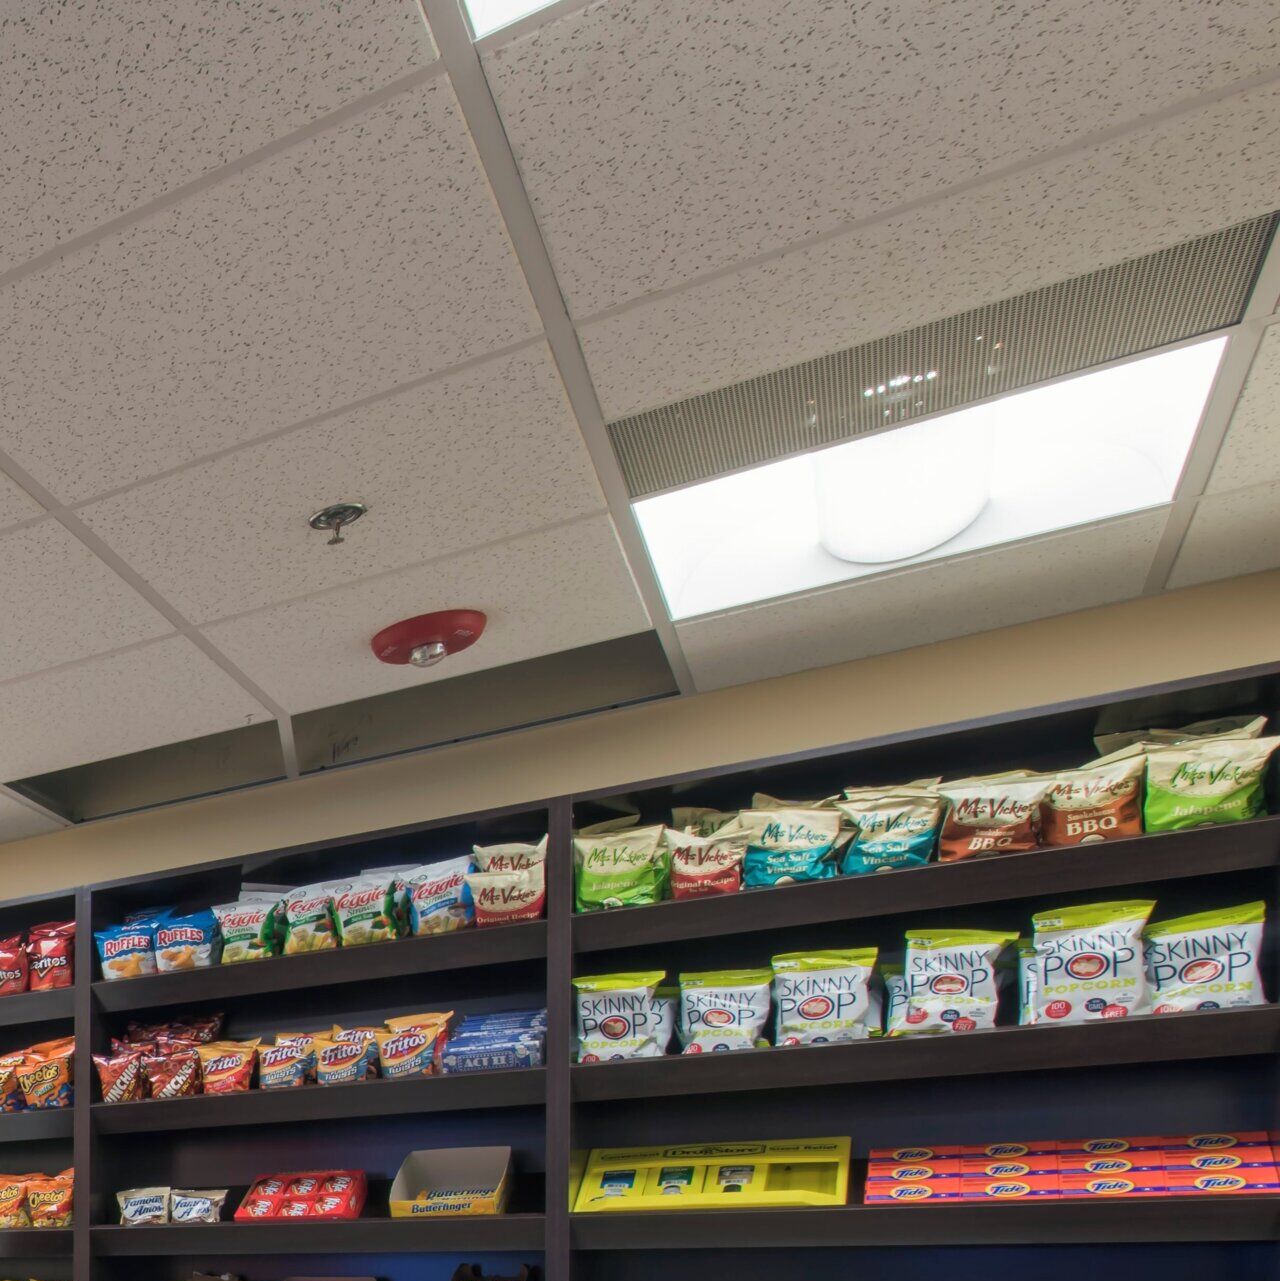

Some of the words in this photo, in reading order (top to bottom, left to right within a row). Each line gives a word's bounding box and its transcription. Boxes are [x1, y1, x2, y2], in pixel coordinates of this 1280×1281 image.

[1083, 779, 1133, 800] Vickie's
[989, 795, 1037, 819] Vickie's
[1067, 808, 1115, 821] Smokehouse
[885, 812, 930, 833] Vickie's
[1066, 816, 1119, 837] BBQ
[784, 824, 829, 844] Vickie's
[968, 835, 1013, 851] BBQ
[698, 844, 738, 866] Vickie's
[766, 853, 787, 864] Sea
[788, 852, 811, 863] Salt
[862, 853, 909, 865] Vinegar
[765, 864, 809, 876] Vinegar
[413, 875, 466, 902] Veggie
[703, 875, 737, 888] Recipe
[334, 886, 387, 912] Veggie
[502, 885, 537, 905] Vickie's
[219, 911, 267, 929] Veggie
[476, 915, 510, 926] Original
[511, 910, 540, 924] Recipe
[105, 937, 151, 957] RUFFLES
[157, 929, 203, 946] RUFFLES
[1041, 927, 1133, 957] SKINNY
[1154, 930, 1247, 964] SKINNY
[912, 949, 989, 973] SKINNY
[1043, 947, 1135, 986] POP
[1153, 950, 1253, 992] POP
[783, 974, 859, 998] SKINNY
[910, 967, 990, 997] POP
[1043, 977, 1137, 997] POPCORN
[581, 995, 647, 1017] SKINNY
[686, 991, 757, 1010] SKINNY
[779, 991, 857, 1025] POP
[582, 1012, 647, 1041] POP
[688, 1006, 756, 1031] POP
[320, 1042, 363, 1065] Fritos
[382, 1031, 427, 1059] Fritos
[204, 1052, 242, 1075] Fritos
[263, 1043, 304, 1067] Fritos
[464, 1055, 489, 1067] ACT
[389, 1057, 423, 1075] TWISTS
[18, 1063, 60, 1094] Cheetos
[804, 1143, 839, 1151] Relief
[991, 1144, 1026, 1157] Tide
[1089, 1139, 1125, 1152] Tide
[1192, 1135, 1232, 1149] Tide
[897, 1147, 931, 1160] Tide
[1195, 1154, 1236, 1169] Tide
[897, 1166, 930, 1179] Tide
[991, 1163, 1026, 1176] Tide
[1091, 1159, 1128, 1173] Tide
[896, 1185, 930, 1198] Tide
[991, 1183, 1028, 1196] Tide
[1092, 1179, 1131, 1193] Tide
[1200, 1175, 1241, 1190] Tide
[28, 1190, 65, 1209] Cheetos
[124, 1195, 165, 1211] Famous
[411, 1201, 473, 1214] Butterfinger
[133, 1203, 164, 1217] Amos
